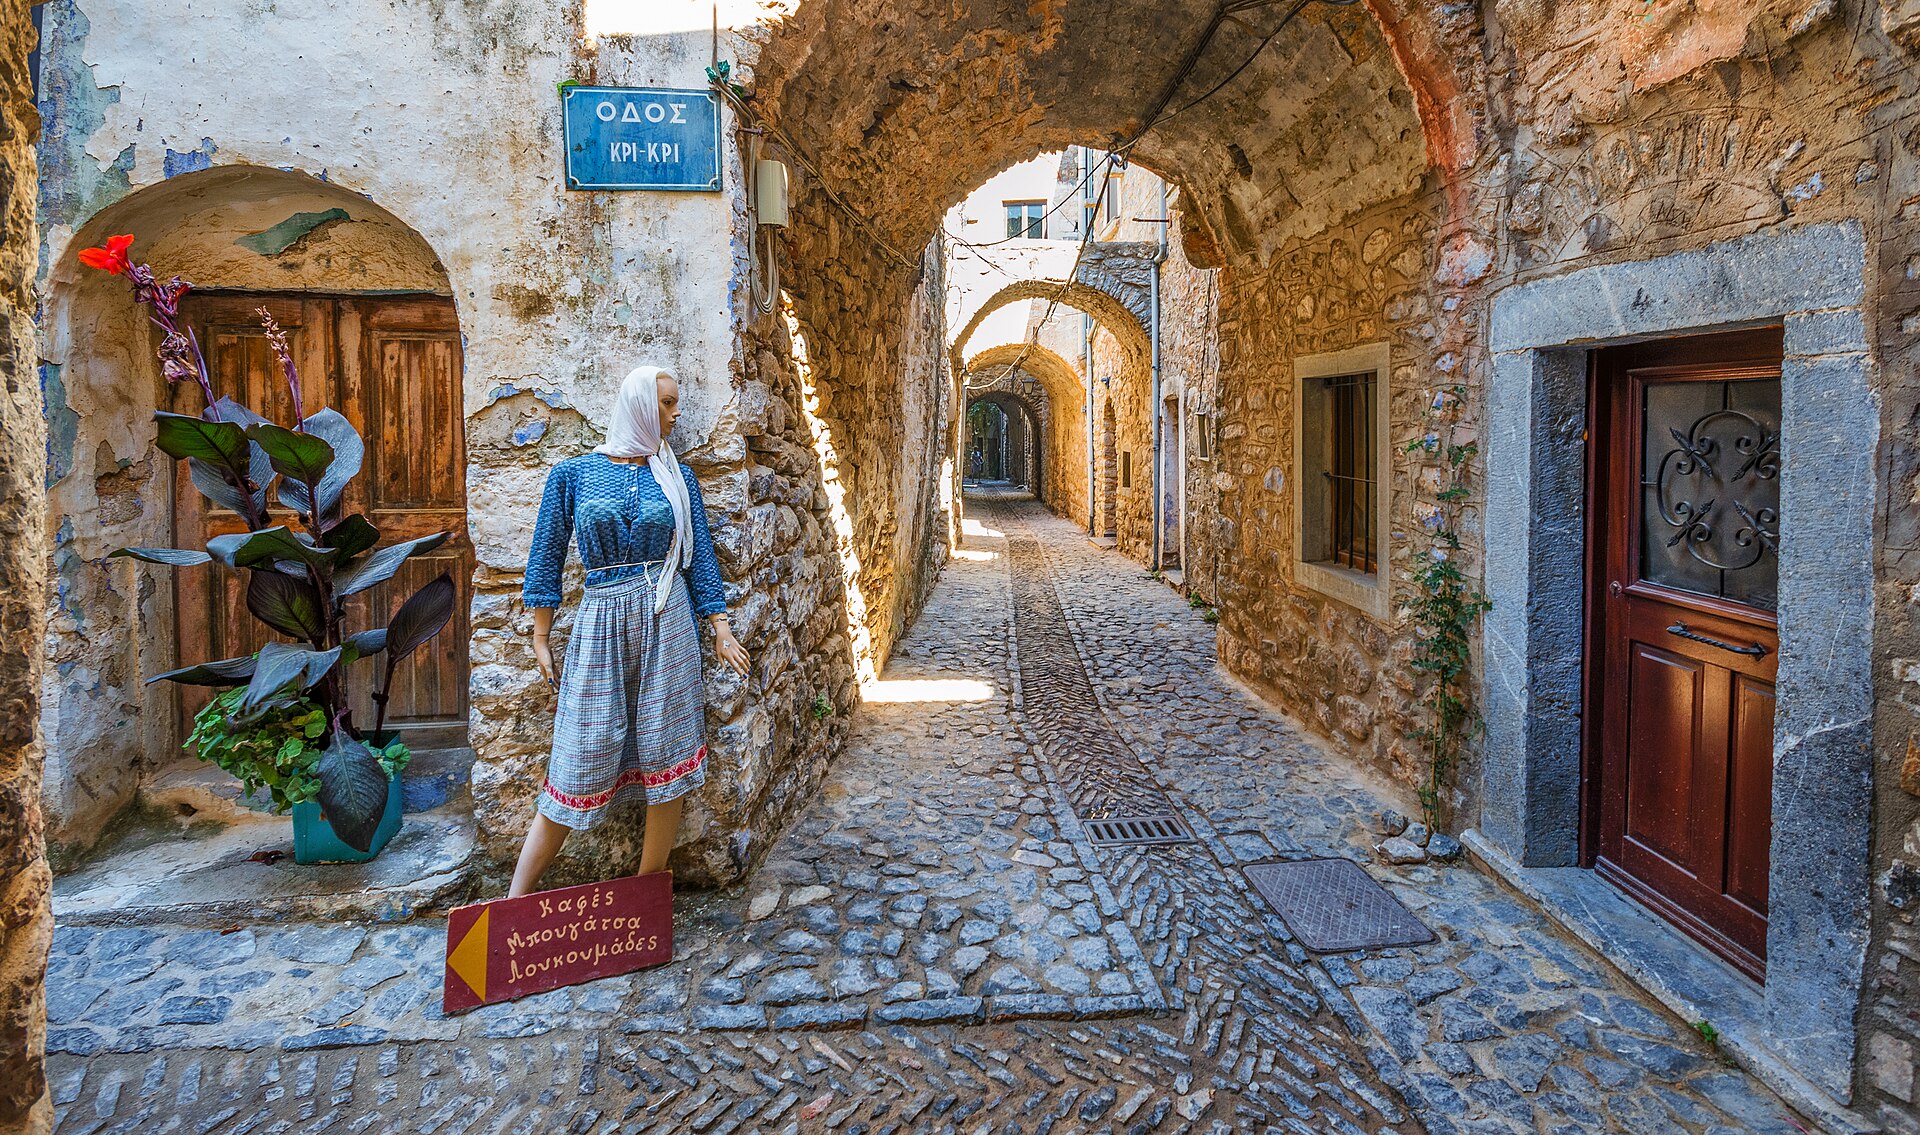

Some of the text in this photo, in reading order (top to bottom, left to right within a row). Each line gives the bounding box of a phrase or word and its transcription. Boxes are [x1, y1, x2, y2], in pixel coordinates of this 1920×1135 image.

[596, 101, 687, 124] ΟΔΟΣ
[610, 142, 679, 163] ΚΡΙ-ΚΡΙ
[539, 887, 614, 918] Καφές
[507, 915, 640, 955] Μπουγάτσα
[508, 931, 658, 984] Λουκουμάδες
